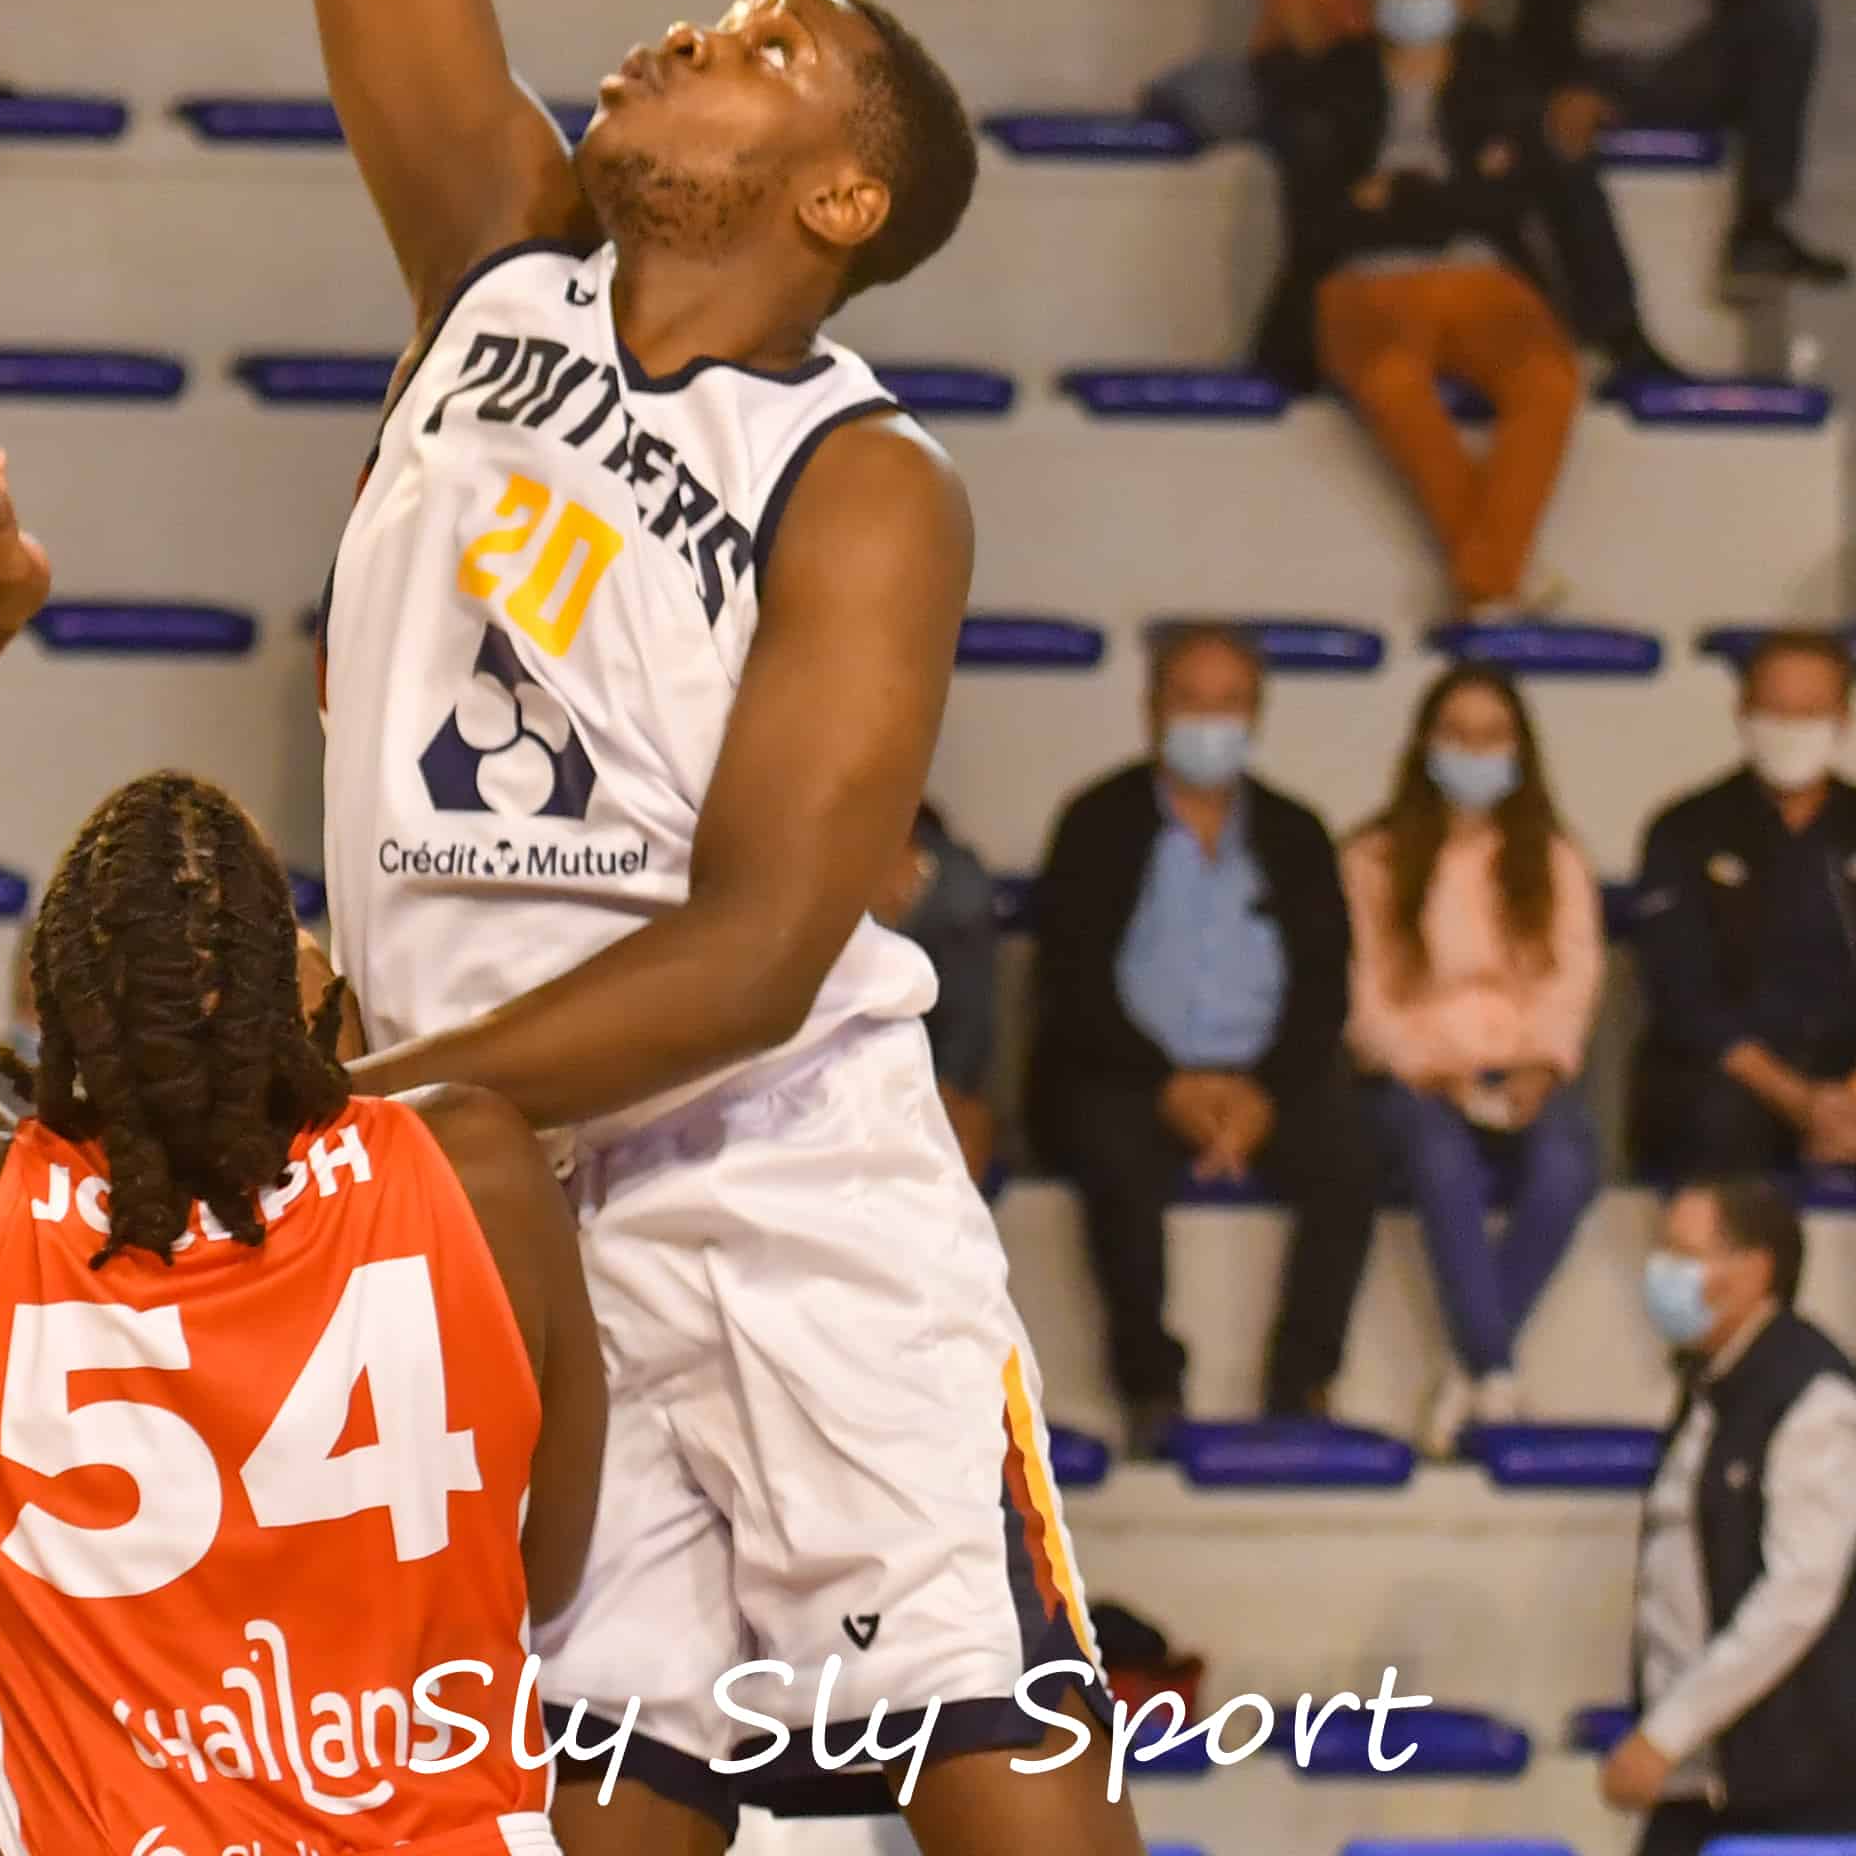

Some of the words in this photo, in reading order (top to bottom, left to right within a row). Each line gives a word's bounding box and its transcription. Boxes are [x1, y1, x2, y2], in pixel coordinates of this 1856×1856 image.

[456, 472, 625, 657] 20
[378, 838, 478, 874] Crédit
[526, 841, 649, 876] Mutuel
[31, 1123, 373, 1252] JOPH
[0, 1255, 483, 1599] 54
